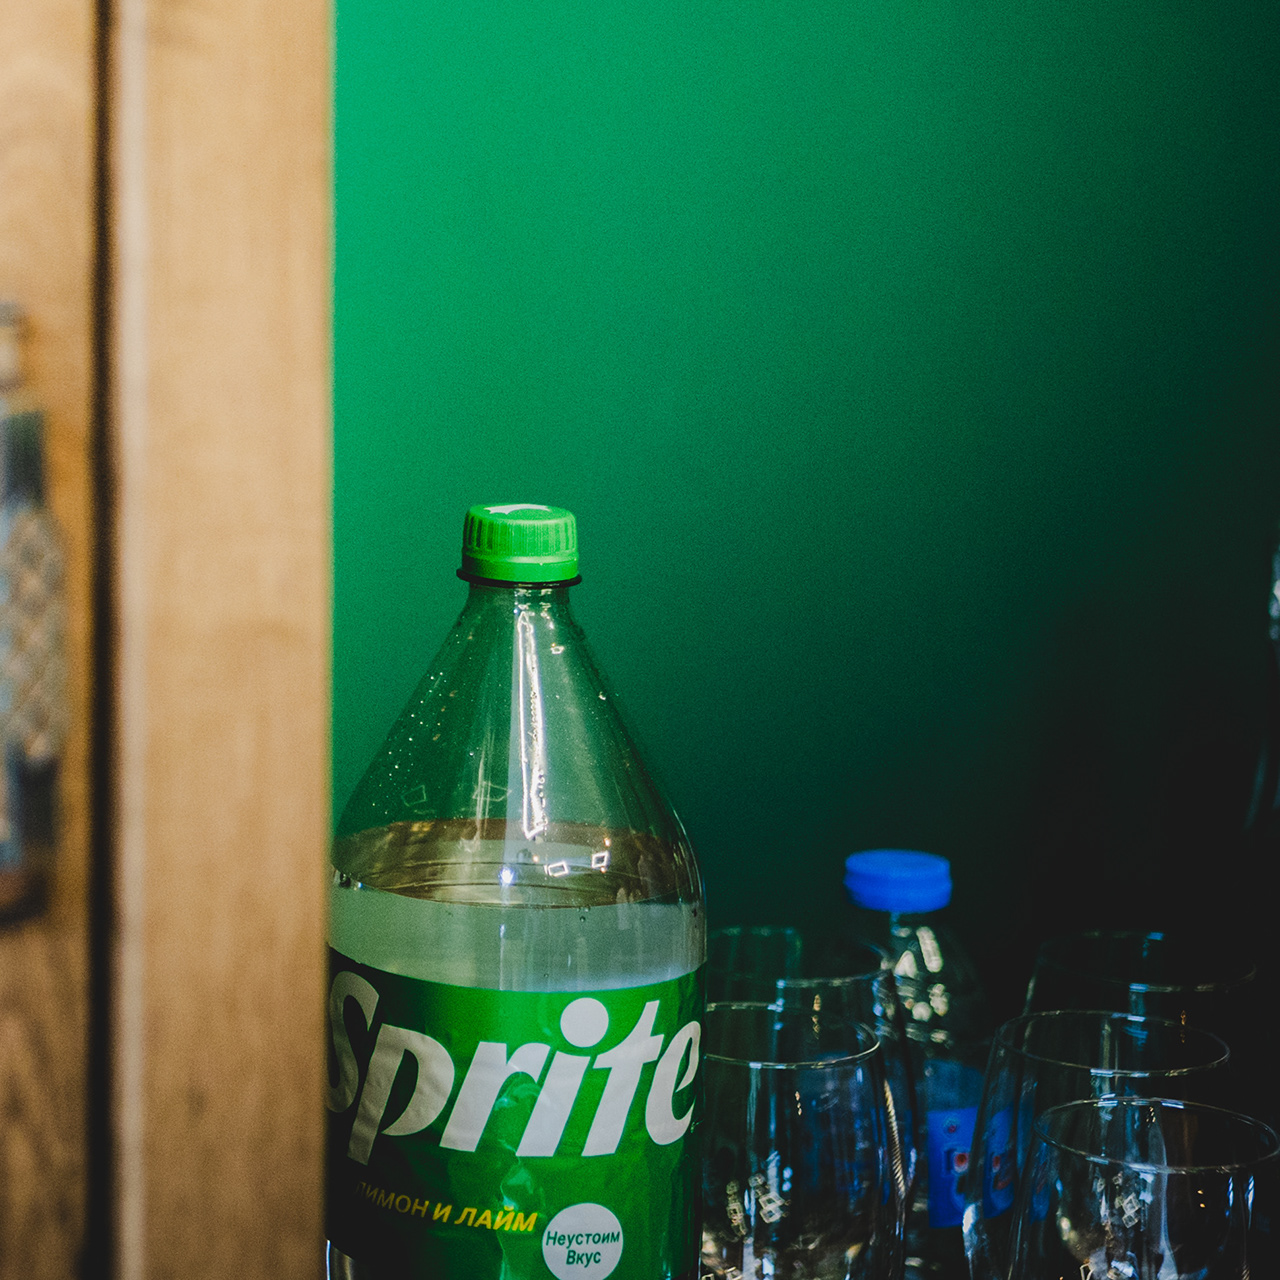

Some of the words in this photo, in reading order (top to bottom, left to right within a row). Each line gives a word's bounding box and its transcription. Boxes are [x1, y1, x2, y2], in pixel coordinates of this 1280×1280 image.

[328, 971, 701, 1165] Sprite
[432, 1202, 452, 1223] И
[454, 1204, 538, 1233] ЛАЙМ
[545, 1231, 621, 1250] Неустоим
[565, 1250, 602, 1268] Вкус
